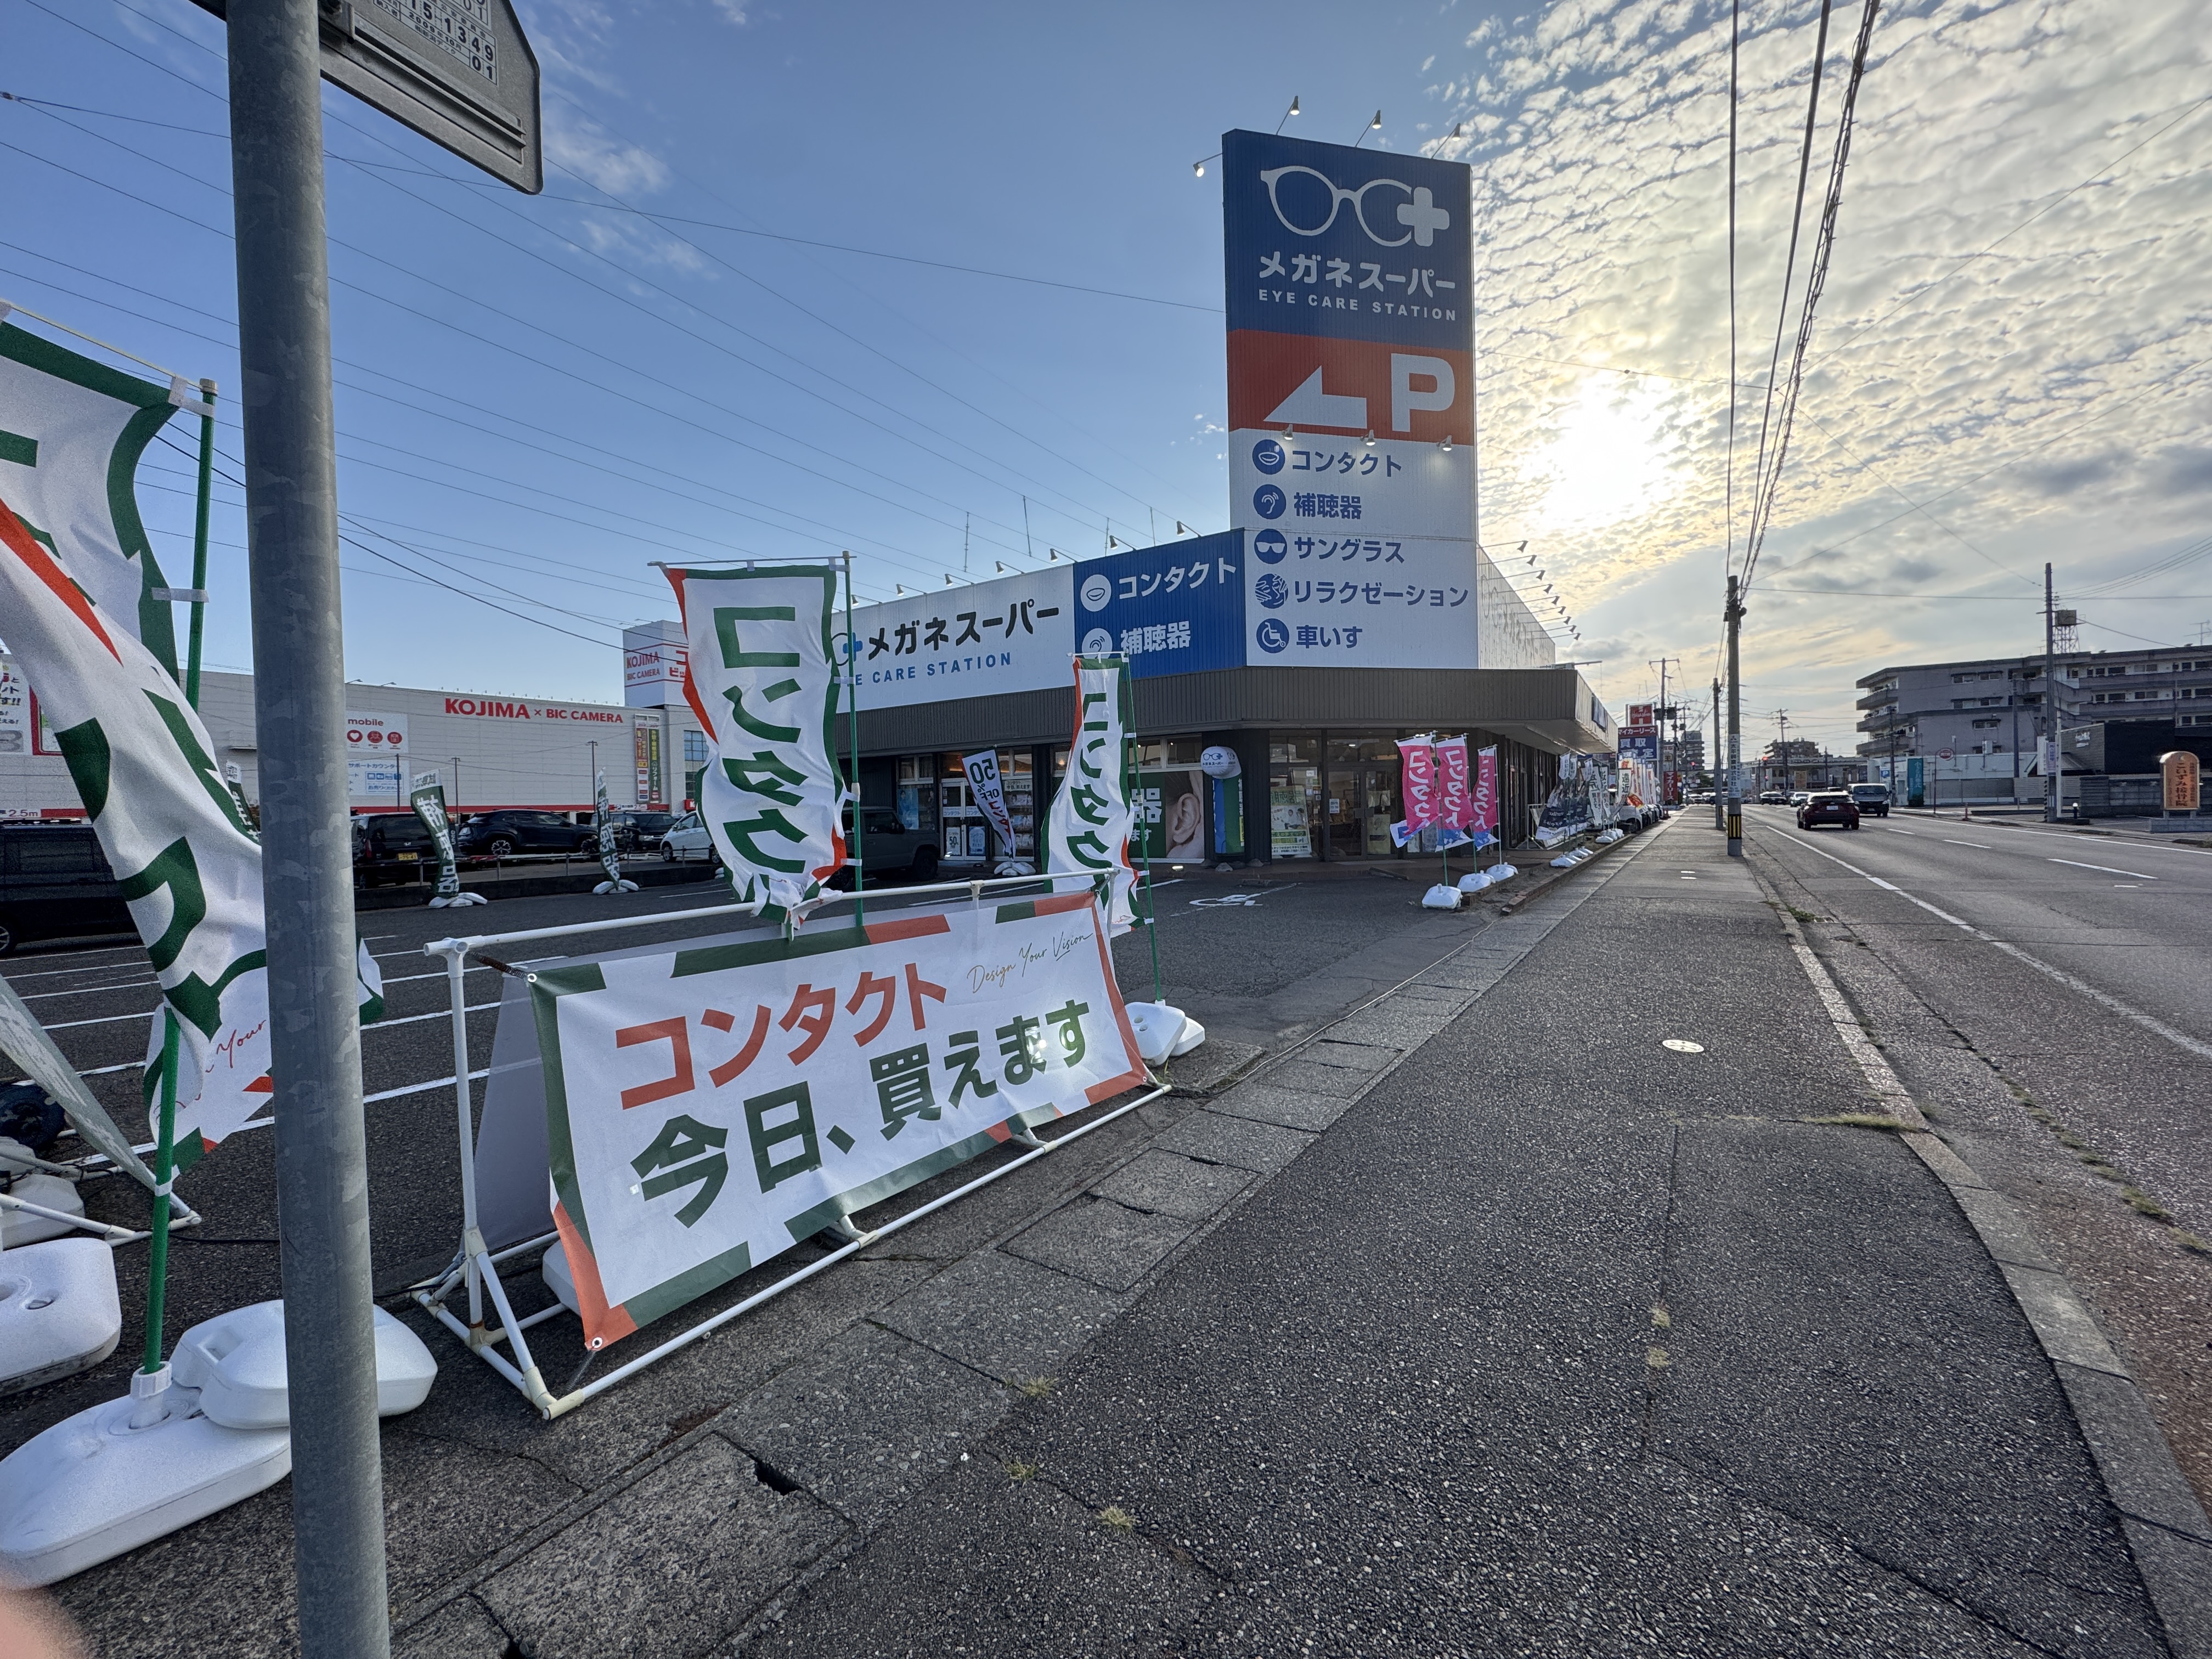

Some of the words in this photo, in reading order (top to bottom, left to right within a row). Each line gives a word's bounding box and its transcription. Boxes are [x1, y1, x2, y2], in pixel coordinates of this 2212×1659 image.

[1260, 251, 1455, 298] メガネスーパー
[1259, 289, 1296, 304] EYE
[1308, 294, 1358, 311] CARE
[1372, 302, 1456, 321] STATION
[1391, 353, 1455, 432] P
[1293, 450, 1402, 477] コンタクト
[1294, 492, 1362, 520] 補聴器
[1295, 537, 1404, 563] サングラス
[1119, 557, 1237, 601] コンタクト
[1295, 580, 1468, 607] リラクゼーション
[868, 598, 1059, 661] メガネスーパー
[1120, 620, 1191, 656] 補聴器
[1296, 624, 1363, 648] 車いす
[627, 651, 660, 669] KOJIMA
[637, 668, 660, 679] CAMERA
[872, 666, 916, 684] CARE
[927, 652, 1012, 677] STATION
[445, 698, 530, 719] KOJIMA
[546, 708, 567, 720] BIC
[571, 712, 623, 724] CAMERA
[1620, 738, 1646, 748] 買取
[967, 963, 1017, 994] Design
[1019, 943, 1047, 978] Your
[1052, 931, 1094, 962] Vision
[217, 1019, 267, 1069] Your
[616, 963, 947, 1109] コンタクト
[630, 1000, 1091, 1229] 今日、買えます
